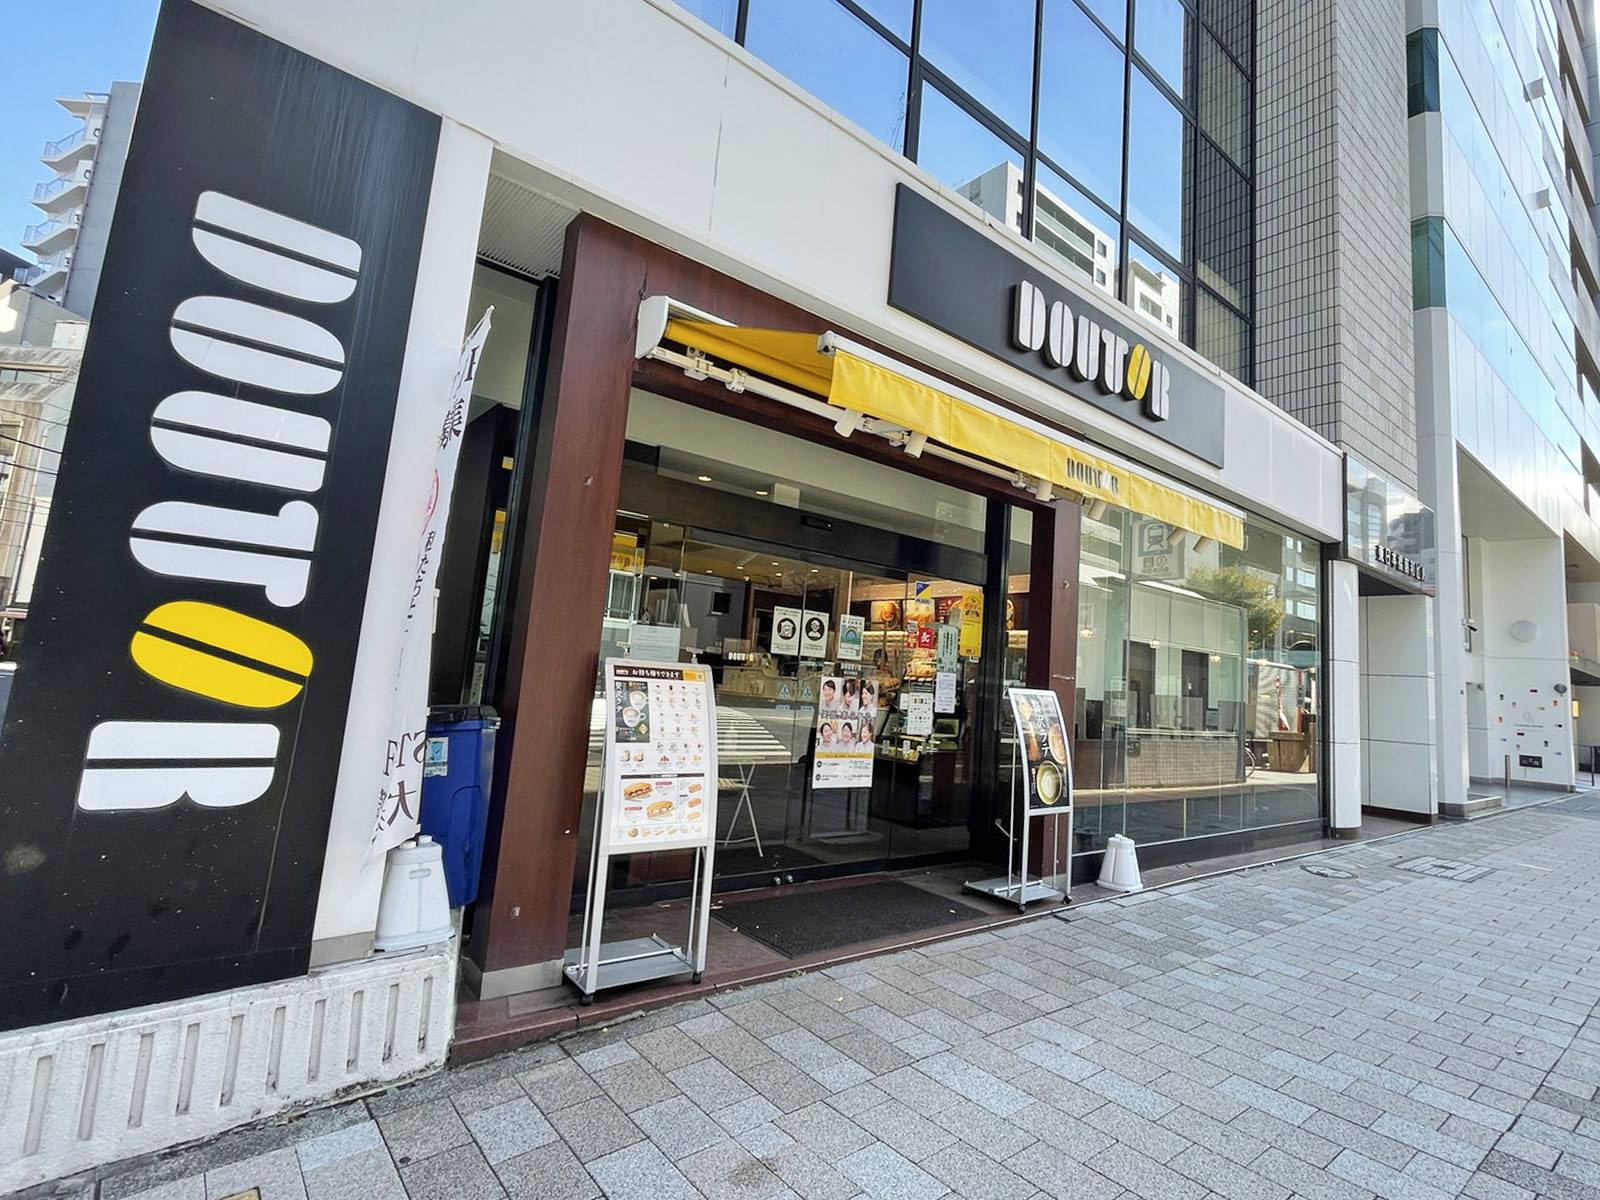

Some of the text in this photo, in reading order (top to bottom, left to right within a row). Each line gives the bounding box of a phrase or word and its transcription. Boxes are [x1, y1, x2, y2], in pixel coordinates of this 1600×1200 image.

[1014, 280, 1171, 420] DOUTOR
[77, 190, 363, 811] DOUTOR
[1067, 458, 1118, 493] DOUTOR
